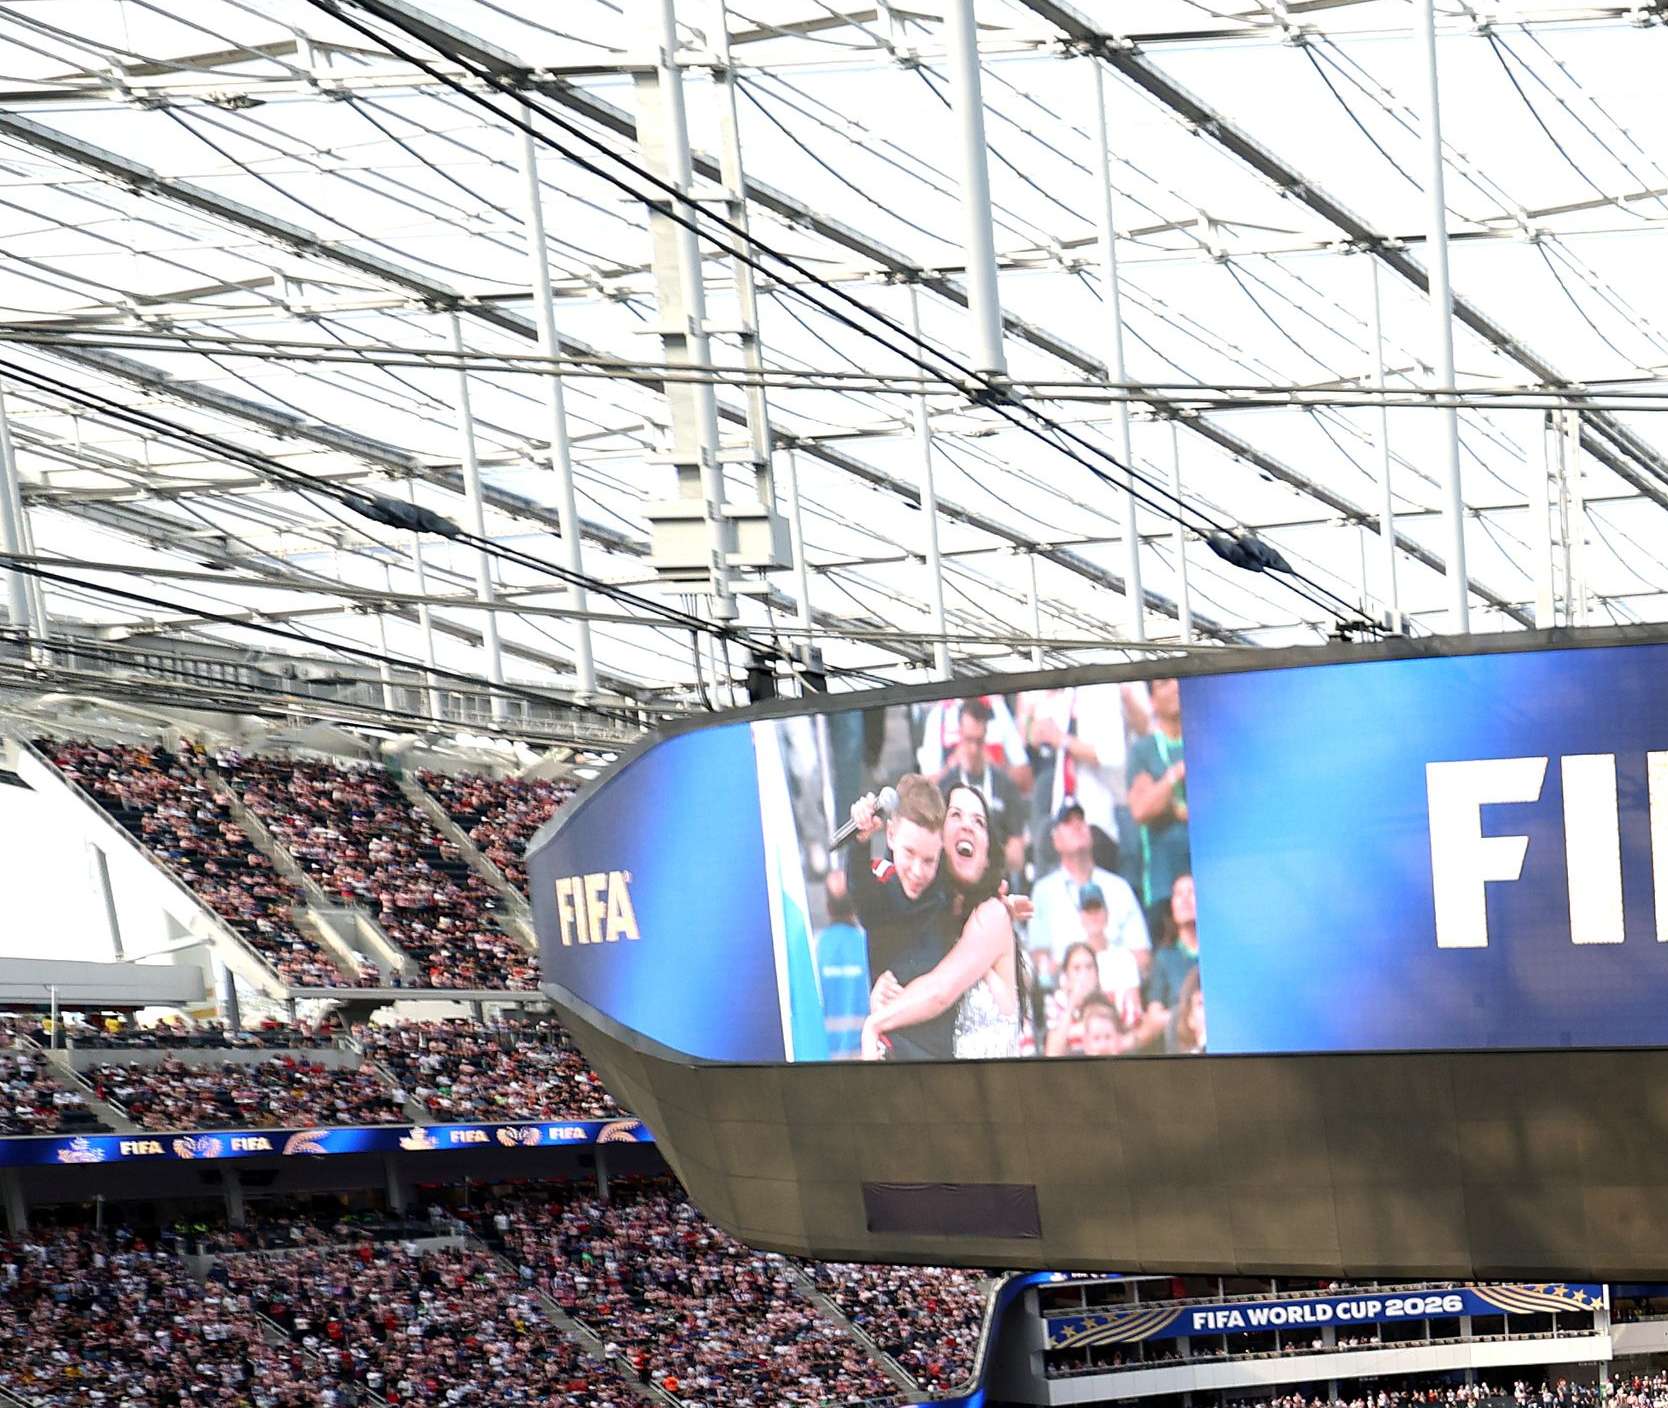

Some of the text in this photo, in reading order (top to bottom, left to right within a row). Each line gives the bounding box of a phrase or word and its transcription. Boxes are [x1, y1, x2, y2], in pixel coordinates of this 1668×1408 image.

[449, 1129, 490, 1144] FIFA
[549, 1127, 587, 1141] FIFA
[120, 1141, 165, 1156] FIFA
[231, 1137, 273, 1152] FIFA
[1192, 1294, 1463, 1331] FIFA WORLD CUP 2026
